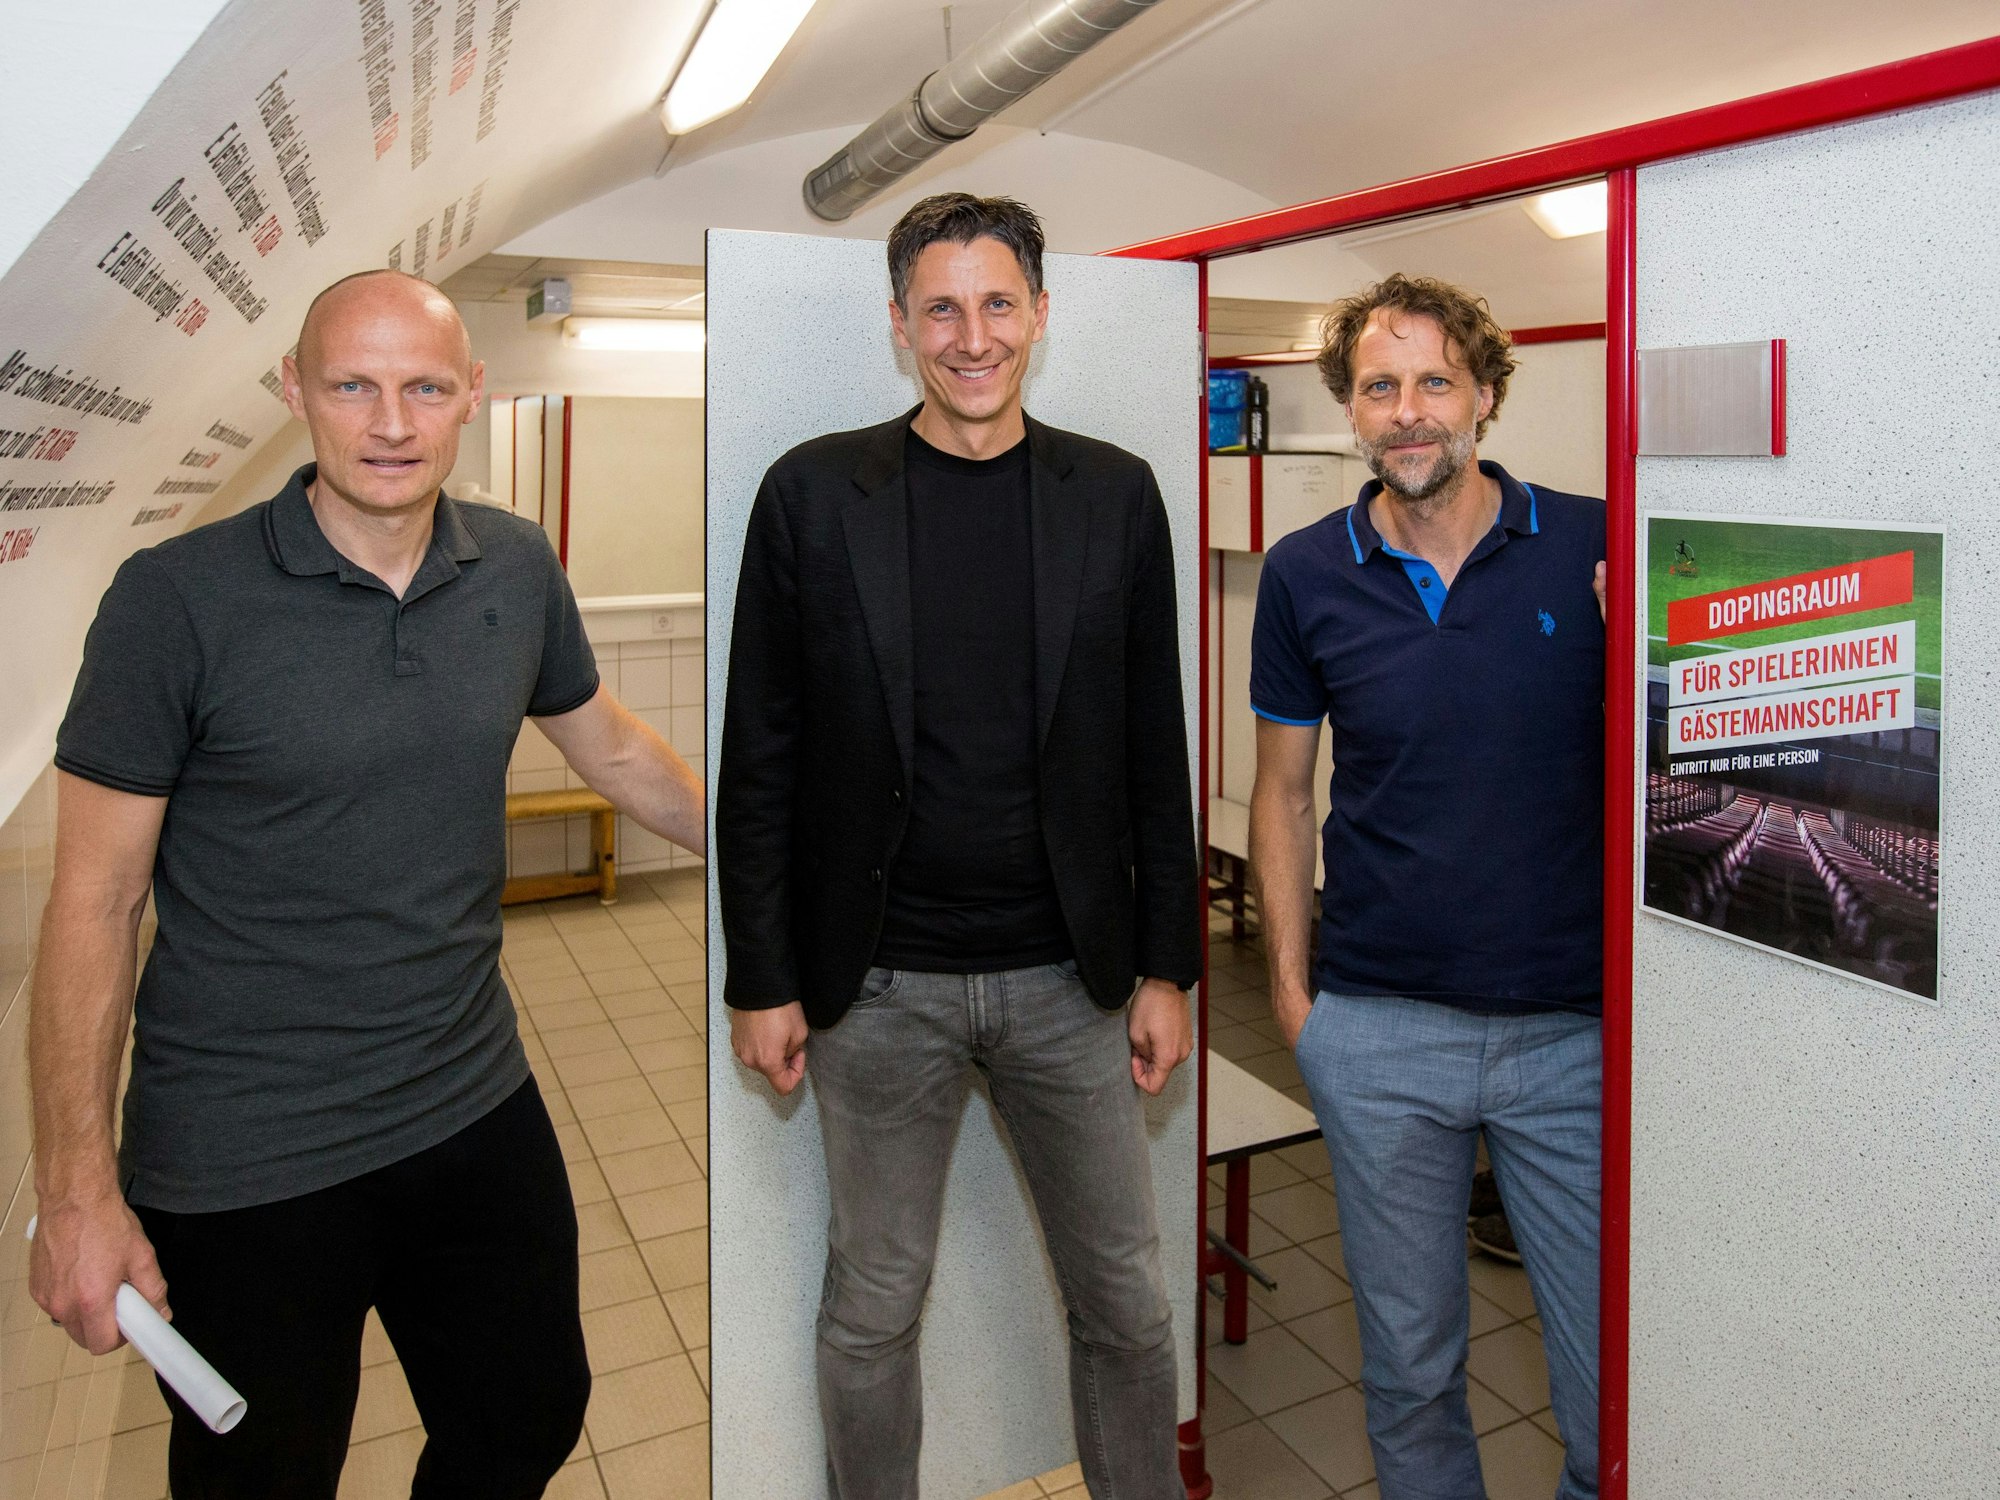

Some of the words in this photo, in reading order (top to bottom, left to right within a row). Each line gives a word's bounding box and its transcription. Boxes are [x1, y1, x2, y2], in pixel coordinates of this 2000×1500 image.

[255, 68, 296, 130] Freud
[367, 65, 396, 107] Fans
[204, 122, 238, 158] E
[268, 113, 300, 152] oder
[208, 132, 251, 187] Jeföhl
[151, 176, 185, 217] Ov
[225, 164, 257, 202] dat
[162, 194, 198, 232] vür
[174, 213, 200, 241] ov
[250, 214, 279, 243] FC
[96, 231, 133, 270] E
[181, 222, 223, 264] zoröck
[104, 239, 157, 290] Jeföhl
[132, 262, 166, 301] dat
[173, 298, 202, 328] FC
[57, 376, 92, 408] dir
[71, 379, 99, 411] he
[13, 425, 46, 459] dir
[28, 428, 62, 460] FC
[42, 429, 79, 462] Kölle
[1709, 572, 1860, 630] DOPINGRAUM
[1682, 660, 1721, 695] FÜR
[1728, 634, 1898, 688] SPIELERINNEN
[1680, 688, 1901, 743] GÄSTEMANNSCHAFT
[1670, 759, 1709, 776] EINTRITT
[1710, 758, 1730, 773] NUR
[1731, 754, 1751, 771] FÜR
[1753, 753, 1776, 769] EINE
[1777, 749, 1820, 766] PERSON
